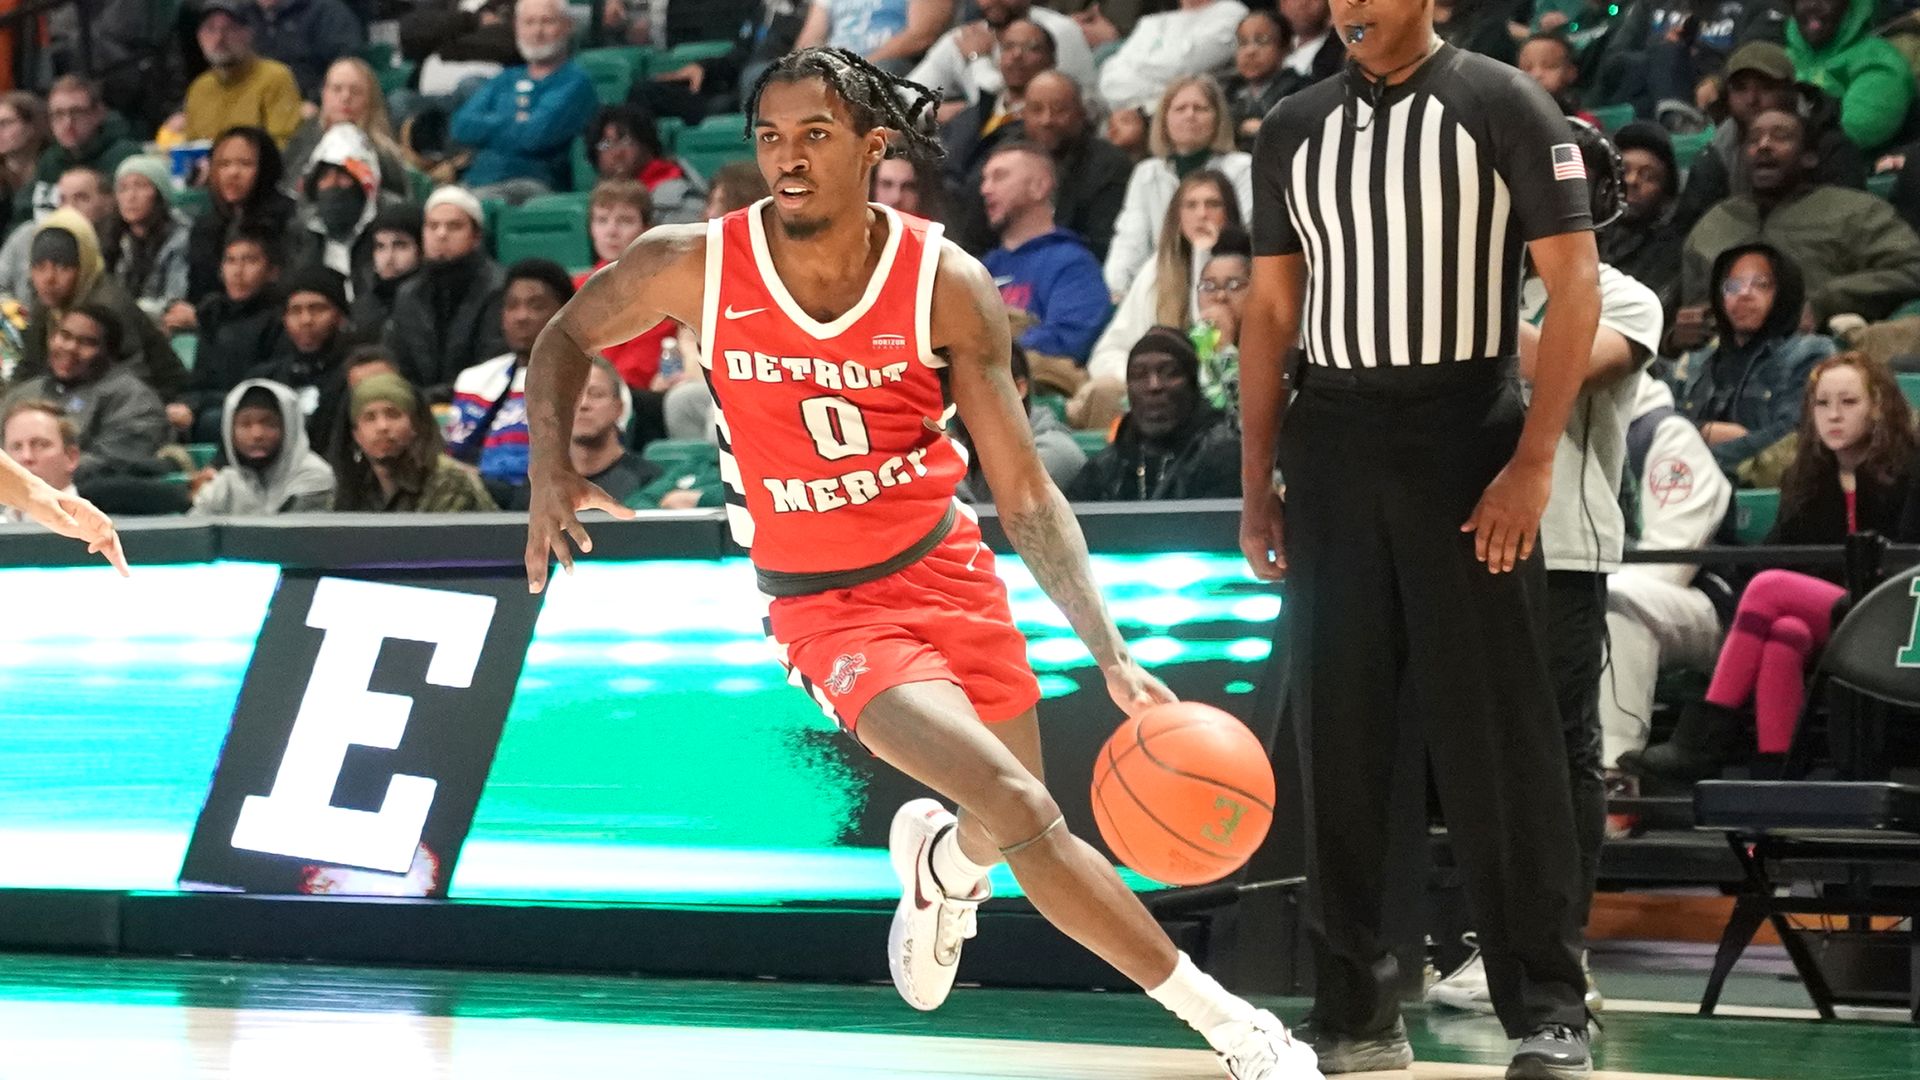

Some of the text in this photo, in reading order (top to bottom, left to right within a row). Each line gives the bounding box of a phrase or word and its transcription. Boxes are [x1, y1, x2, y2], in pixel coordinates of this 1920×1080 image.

[724, 350, 908, 390] DETROIT
[799, 394, 870, 461] 0
[762, 448, 929, 513] MERCY
[231, 576, 497, 874] E
